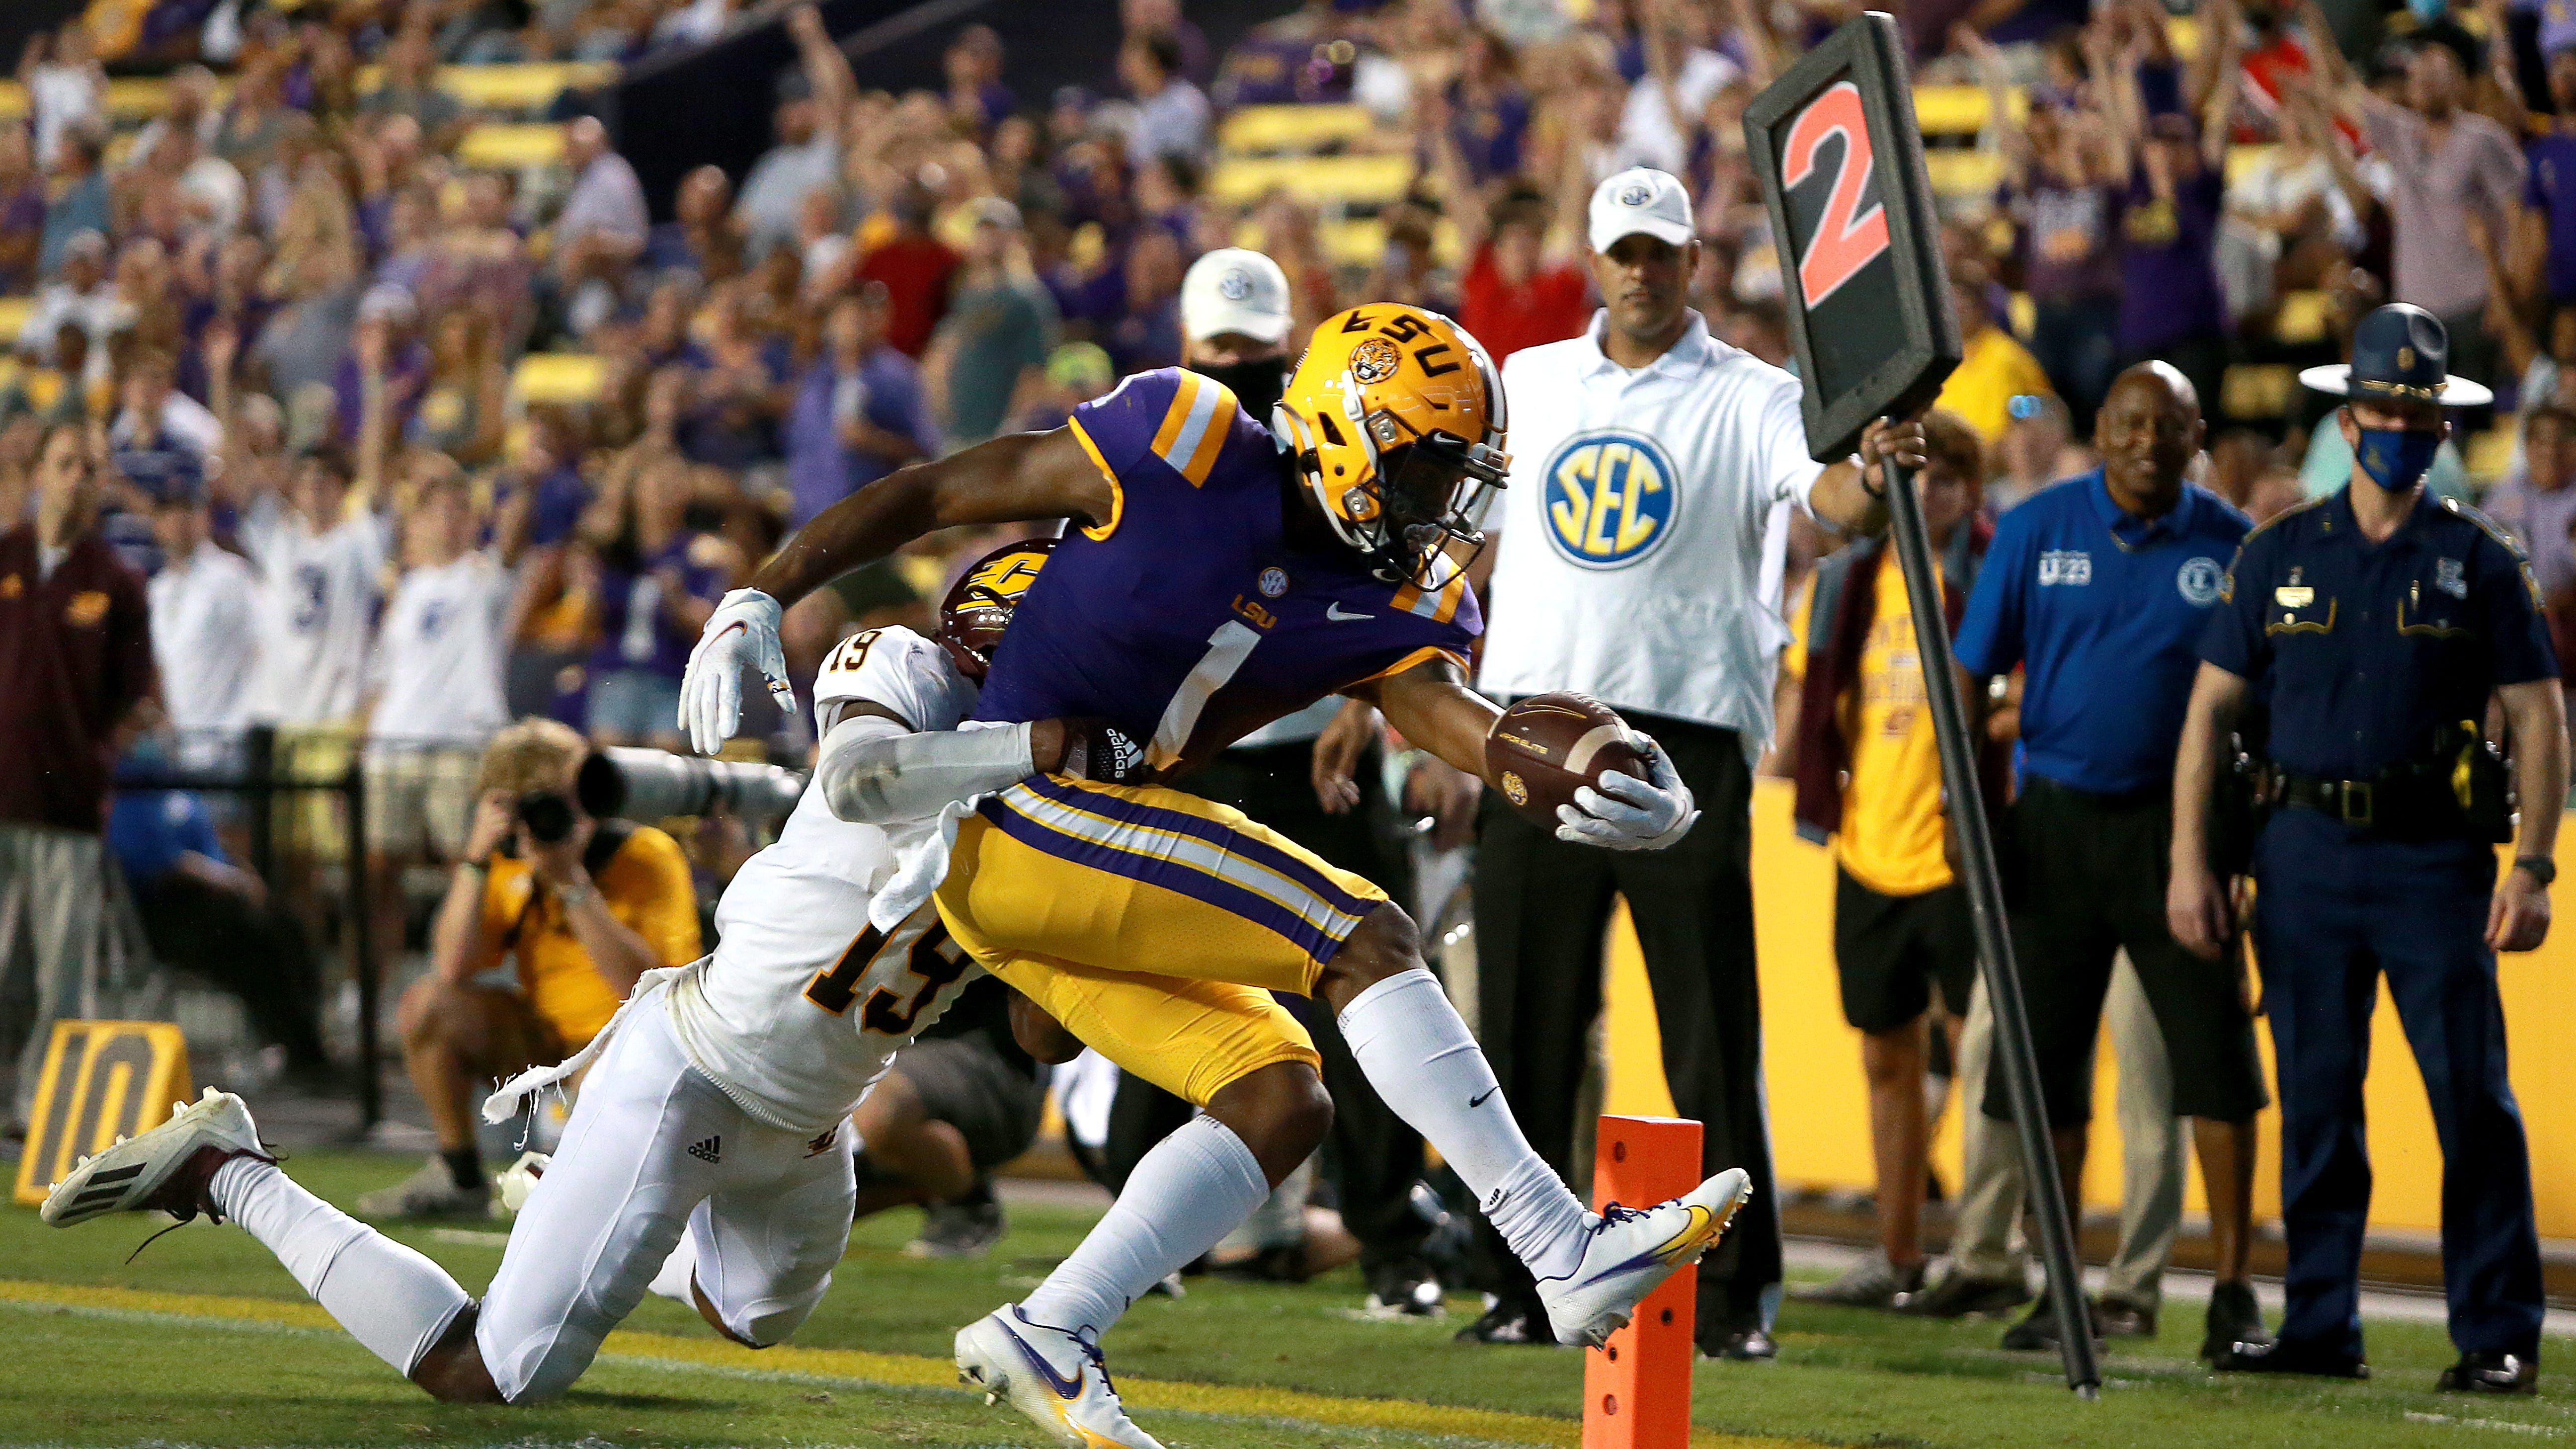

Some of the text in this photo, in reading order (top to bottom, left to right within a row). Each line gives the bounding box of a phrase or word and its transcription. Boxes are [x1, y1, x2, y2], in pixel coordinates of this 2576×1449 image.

[1781, 80, 1890, 311] 2
[1341, 309, 1460, 378] LSU
[1550, 442, 1663, 556] SEC
[829, 630, 883, 673] 19
[1231, 594, 1278, 629] LSU
[1144, 620, 1262, 771] 1
[1106, 728, 1127, 778] adidas
[803, 894, 978, 1036] 19
[30, 1033, 154, 1187] 10
[688, 1146, 721, 1164] adidas
